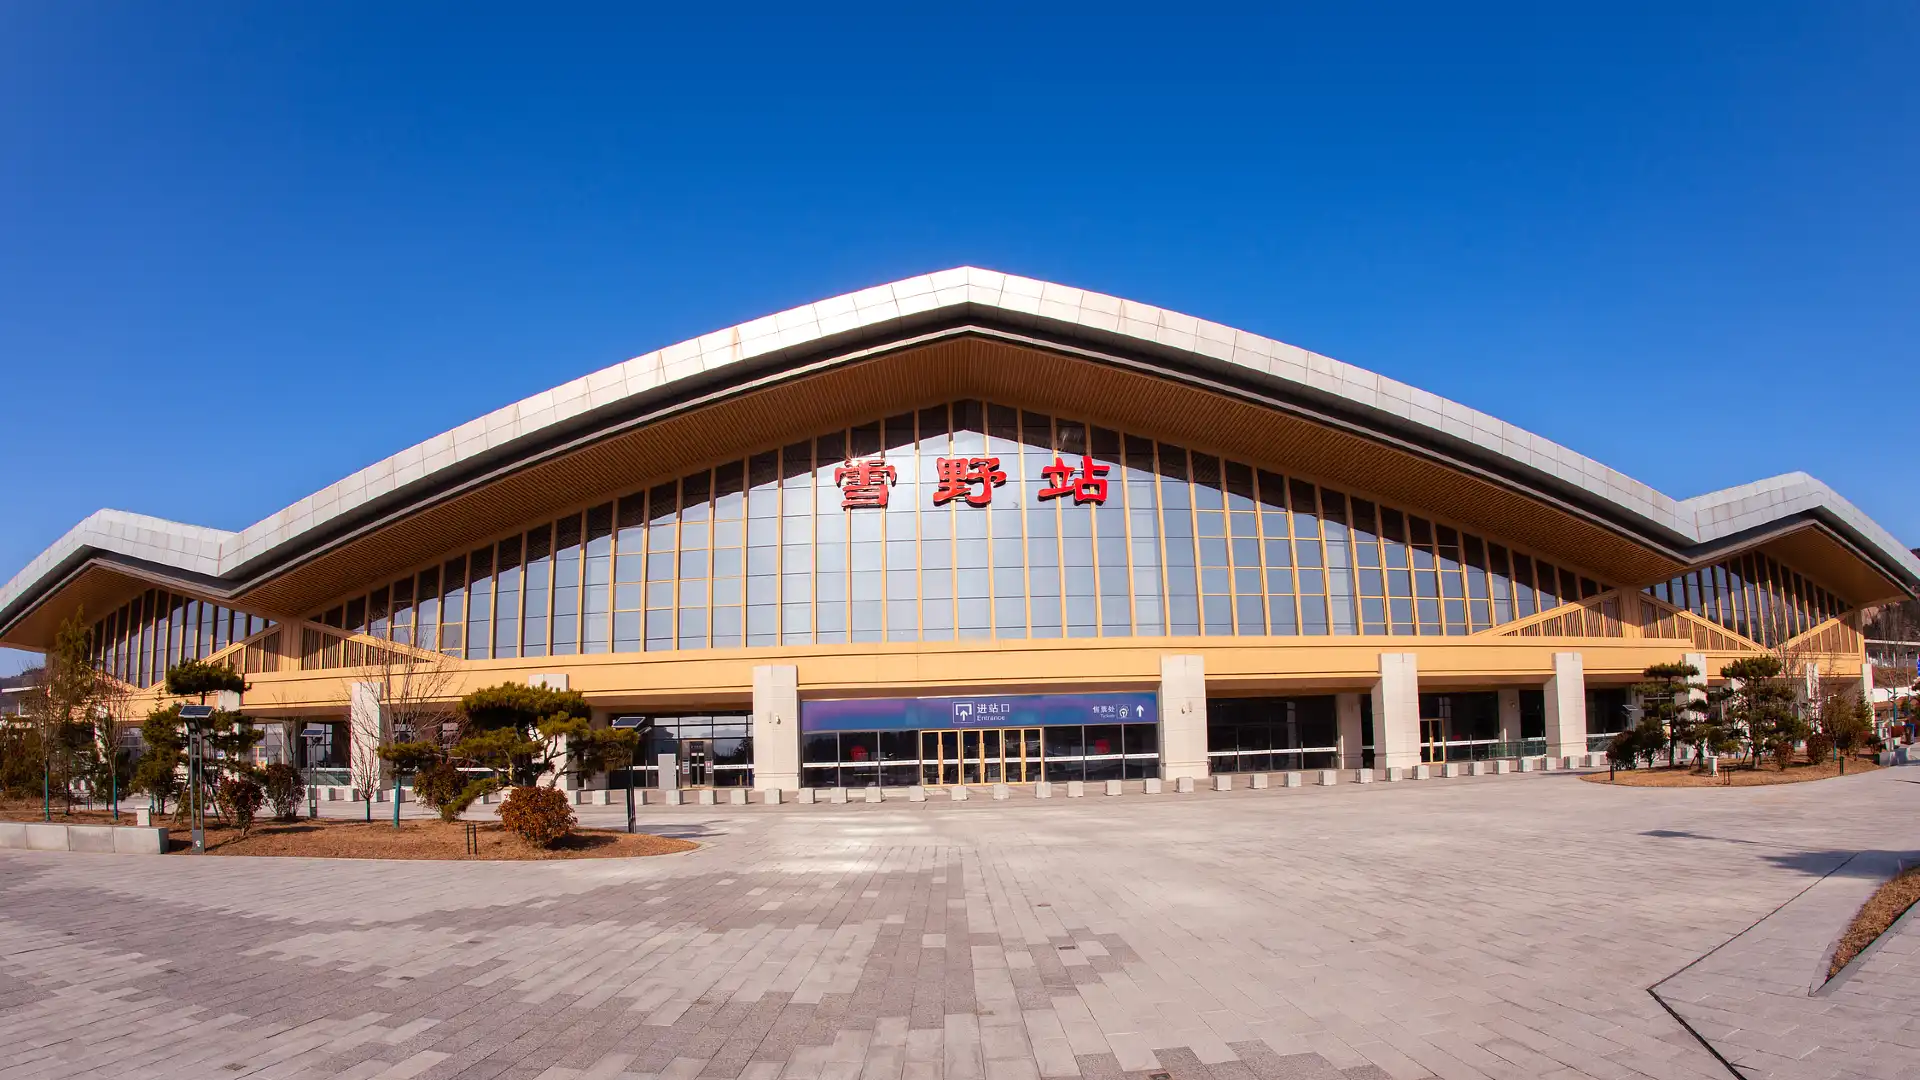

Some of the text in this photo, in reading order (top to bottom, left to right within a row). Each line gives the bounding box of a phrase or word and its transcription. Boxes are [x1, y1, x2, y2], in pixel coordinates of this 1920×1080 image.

[834, 456, 1111, 509] 雪野站
[977, 703, 1010, 714] 进站口
